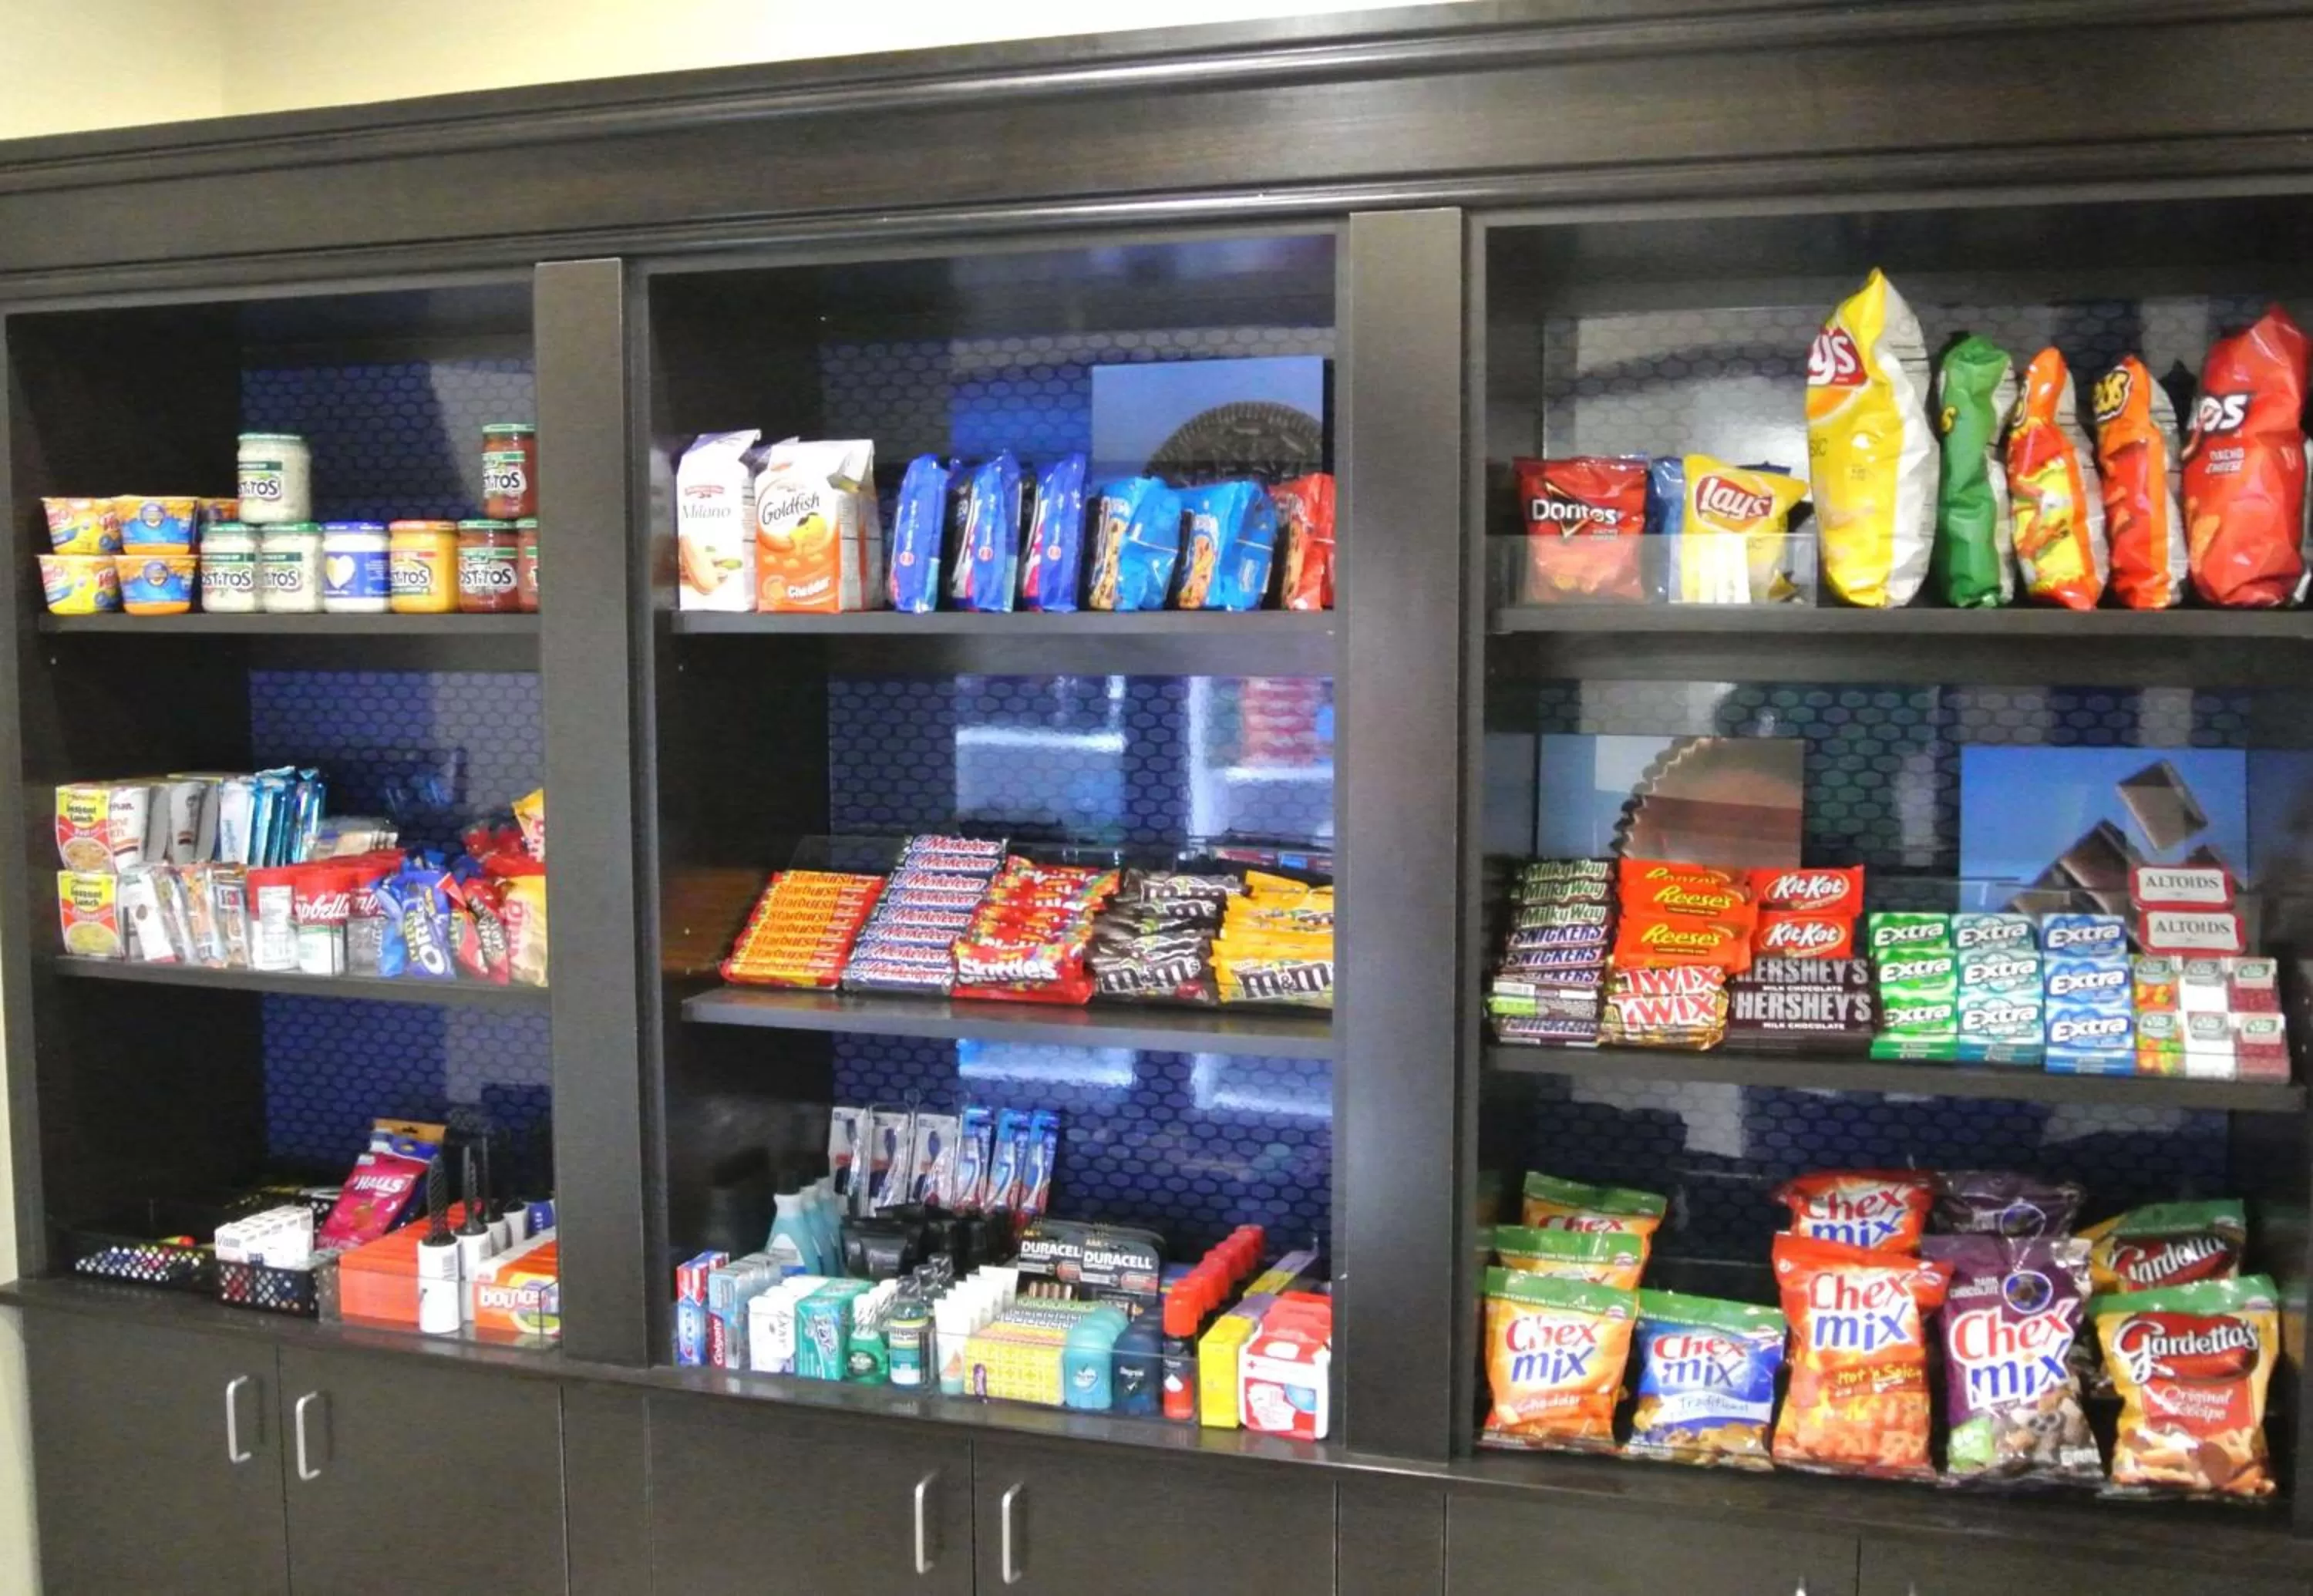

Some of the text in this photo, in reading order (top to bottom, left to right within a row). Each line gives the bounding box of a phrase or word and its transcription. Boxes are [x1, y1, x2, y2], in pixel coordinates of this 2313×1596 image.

[762, 491, 820, 526] Goldfish
[1532, 498, 1618, 524] Doritos
[1701, 476, 1772, 521] Lay's
[2146, 874, 2220, 889] ALTOIDS
[1653, 884, 1733, 909] Reese's
[1568, 904, 1606, 924] Way
[2156, 919, 2231, 934] ALTOIDS
[1511, 926, 1604, 945] SNICKERS
[1641, 923, 1722, 947] Reese's
[1874, 923, 1944, 947] Extra
[1957, 923, 2029, 948] Extra
[2047, 924, 2120, 948] Extra
[1507, 948, 1599, 965] SNICKERS
[958, 958, 1059, 985] Skittles
[1616, 965, 1724, 994] TWIX
[1880, 958, 1952, 983] Extra
[1964, 960, 2038, 985] Extra
[2049, 971, 2125, 995] Extra
[1786, 985, 1843, 993] CHOCOLATE
[1608, 995, 1718, 1032] TWIX
[1735, 992, 1873, 1022] HERSHEY'S
[1884, 1005, 1952, 1028] Extra
[1962, 1006, 2038, 1031] Extra
[1763, 1022, 1845, 1031] MILK CHOCOLATE
[2051, 1017, 2128, 1042] Extra
[354, 1174, 406, 1193] HALLS
[1807, 1187, 1902, 1221] Chex
[1811, 1210, 1904, 1247] mix
[1021, 1240, 1082, 1258] DURACEL
[1083, 1250, 1153, 1270] DURACELL
[1810, 1271, 1911, 1312] Chex
[1506, 1315, 1600, 1353] Chex
[1814, 1301, 1910, 1351] mix
[1952, 1308, 2072, 1362] Chex
[1653, 1335, 1747, 1359] Chex
[2113, 1318, 2261, 1384] Gardetto's
[1511, 1346, 1595, 1384] mix
[1662, 1355, 1746, 1387] mix
[1970, 1338, 2069, 1398] mix
[2160, 1387, 2233, 1409] Original
